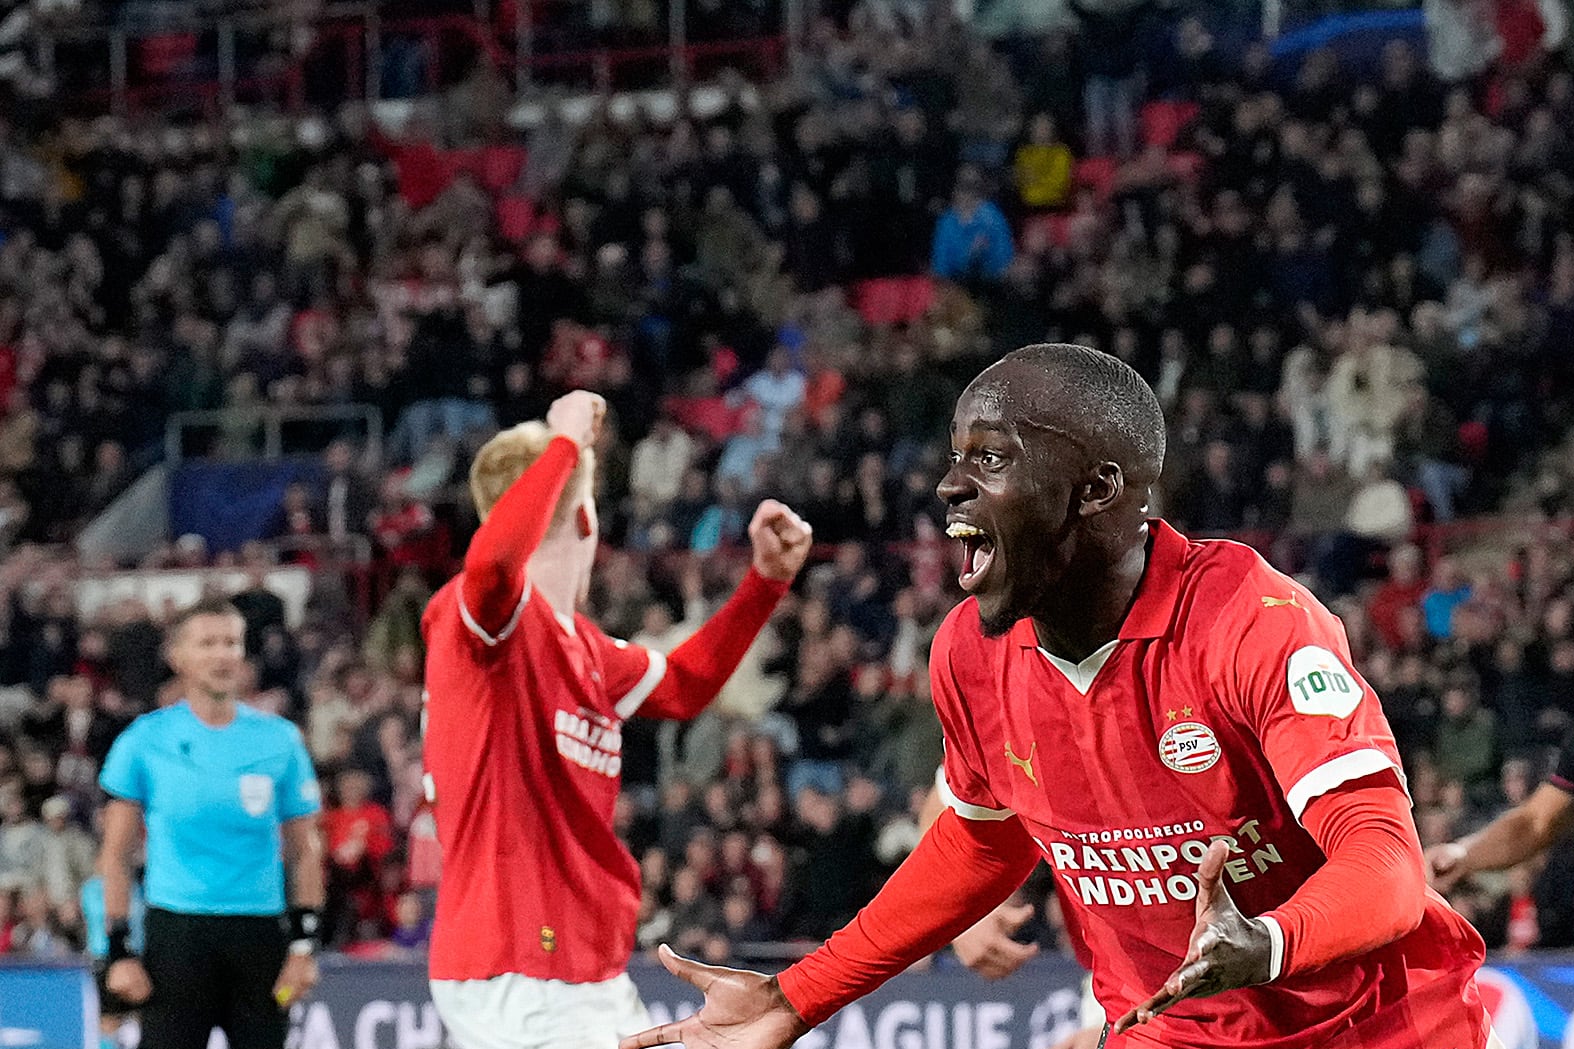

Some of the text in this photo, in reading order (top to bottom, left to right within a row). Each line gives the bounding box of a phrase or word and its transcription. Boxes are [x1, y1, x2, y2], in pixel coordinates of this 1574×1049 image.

[1293, 670, 1351, 702] TOTO
[1178, 739, 1198, 753] PSV
[1032, 819, 1261, 872] RAINPORT
[1061, 843, 1283, 906] NDHOEN
